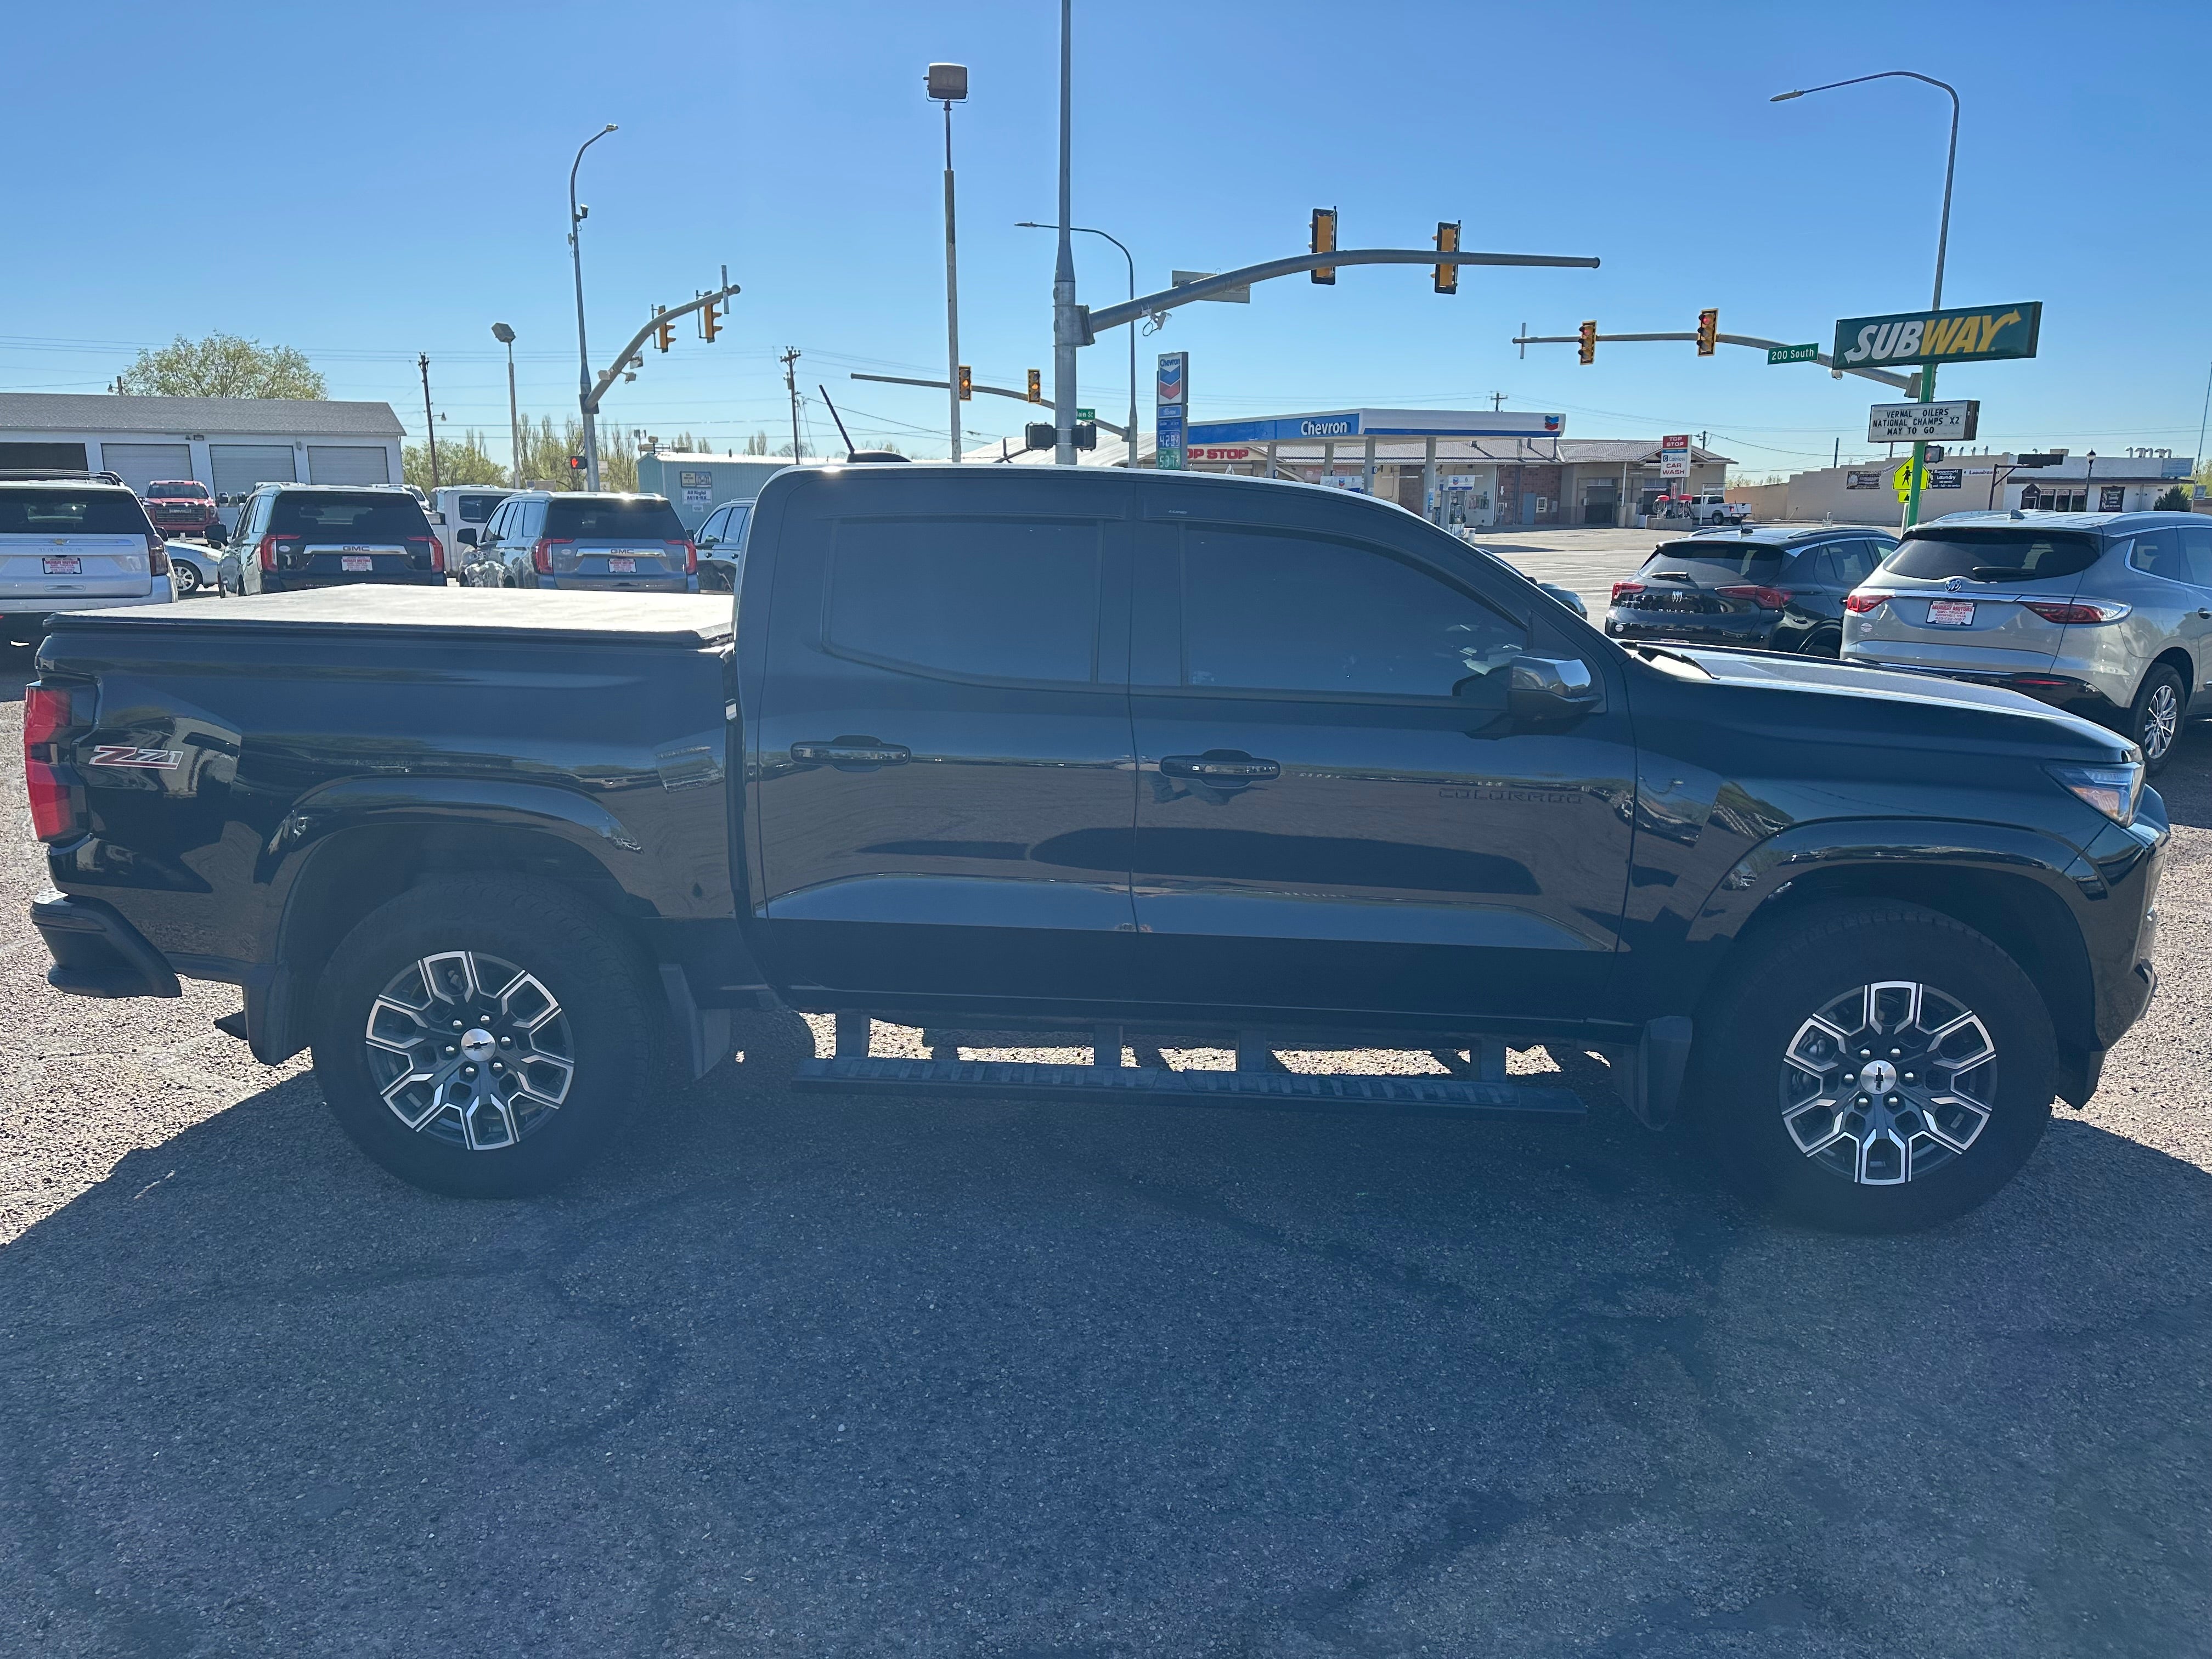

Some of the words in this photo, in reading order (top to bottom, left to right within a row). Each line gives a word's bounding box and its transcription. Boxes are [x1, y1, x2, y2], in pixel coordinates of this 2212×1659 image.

[1844, 309, 2022, 364] SUBWAY
[1771, 350, 1787, 360] 200
[1790, 348, 1814, 358] South
[1160, 359, 1180, 367] Chevron
[1922, 408, 1949, 416] OILERS
[1913, 417, 1943, 426] CHAMPS
[1301, 420, 1347, 436] Chevron
[1187, 448, 1204, 459] OP
[1207, 448, 1249, 459] STOP
[88, 745, 184, 770] Z71
[1439, 788, 1583, 804] COLORADO
